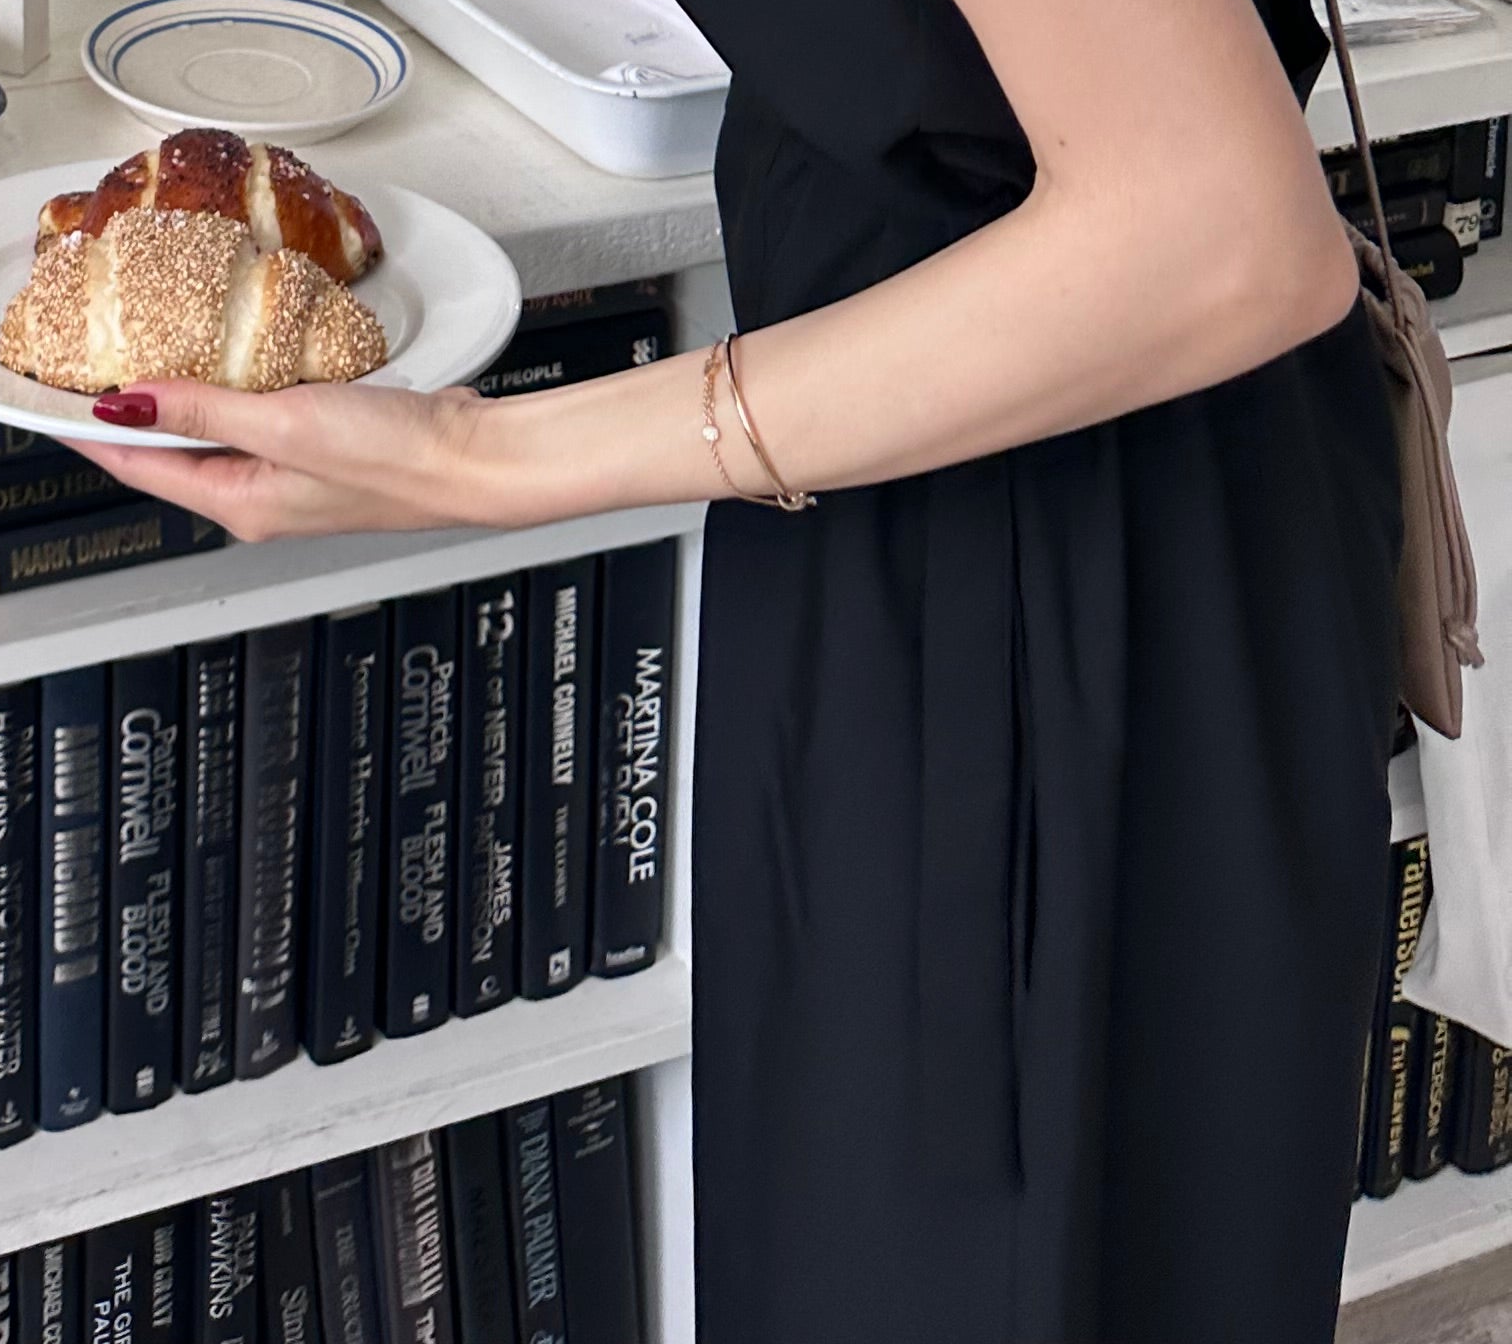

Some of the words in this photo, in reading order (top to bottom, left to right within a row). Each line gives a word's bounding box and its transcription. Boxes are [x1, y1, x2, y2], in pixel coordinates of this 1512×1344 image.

[1454, 214, 1479, 235] 79
[501, 361, 565, 390] PEOPLE
[11, 538, 73, 581] MARK
[76, 517, 164, 566] DAWSON
[552, 585, 577, 681] MICHAEL
[344, 652, 376, 750] Joanne
[399, 644, 440, 796] Cornwell
[427, 659, 456, 768] Patricia
[550, 683, 576, 789] CONNELLY
[629, 646, 664, 794] MARTINA
[120, 706, 161, 866] Cornwell
[151, 723, 179, 837] Patricia
[349, 750, 375, 842] Harris
[482, 707, 507, 811] NEVER
[398, 834, 424, 926] BLOOD
[423, 799, 449, 886] FLESH
[492, 841, 514, 929] JAMES
[626, 794, 659, 886] COLE
[121, 902, 148, 997] BLOOD
[147, 867, 173, 962] FLESH
[422, 885, 446, 945] AND
[145, 961, 171, 1017] AND
[41, 1244, 65, 1324] MICHAEL
[113, 1253, 134, 1305] THE
[208, 1198, 236, 1321] HAWKINS
[231, 1209, 258, 1297] PAULA
